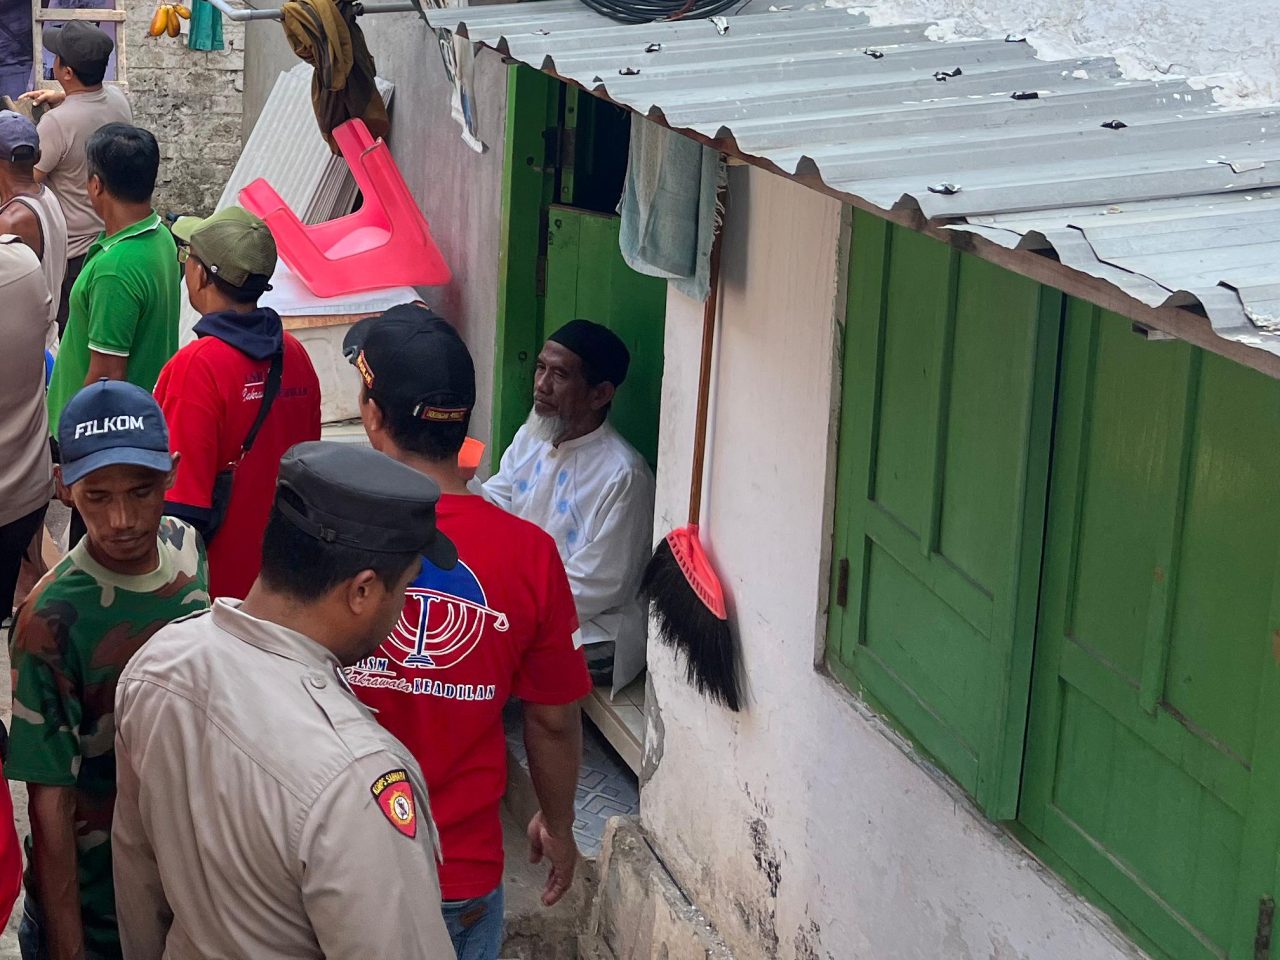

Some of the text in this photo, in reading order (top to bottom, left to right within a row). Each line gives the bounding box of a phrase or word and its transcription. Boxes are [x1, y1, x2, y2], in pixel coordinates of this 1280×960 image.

[74, 415, 145, 440] FILKOM
[356, 656, 389, 672] LSM
[412, 677, 496, 701] KEADILAN
